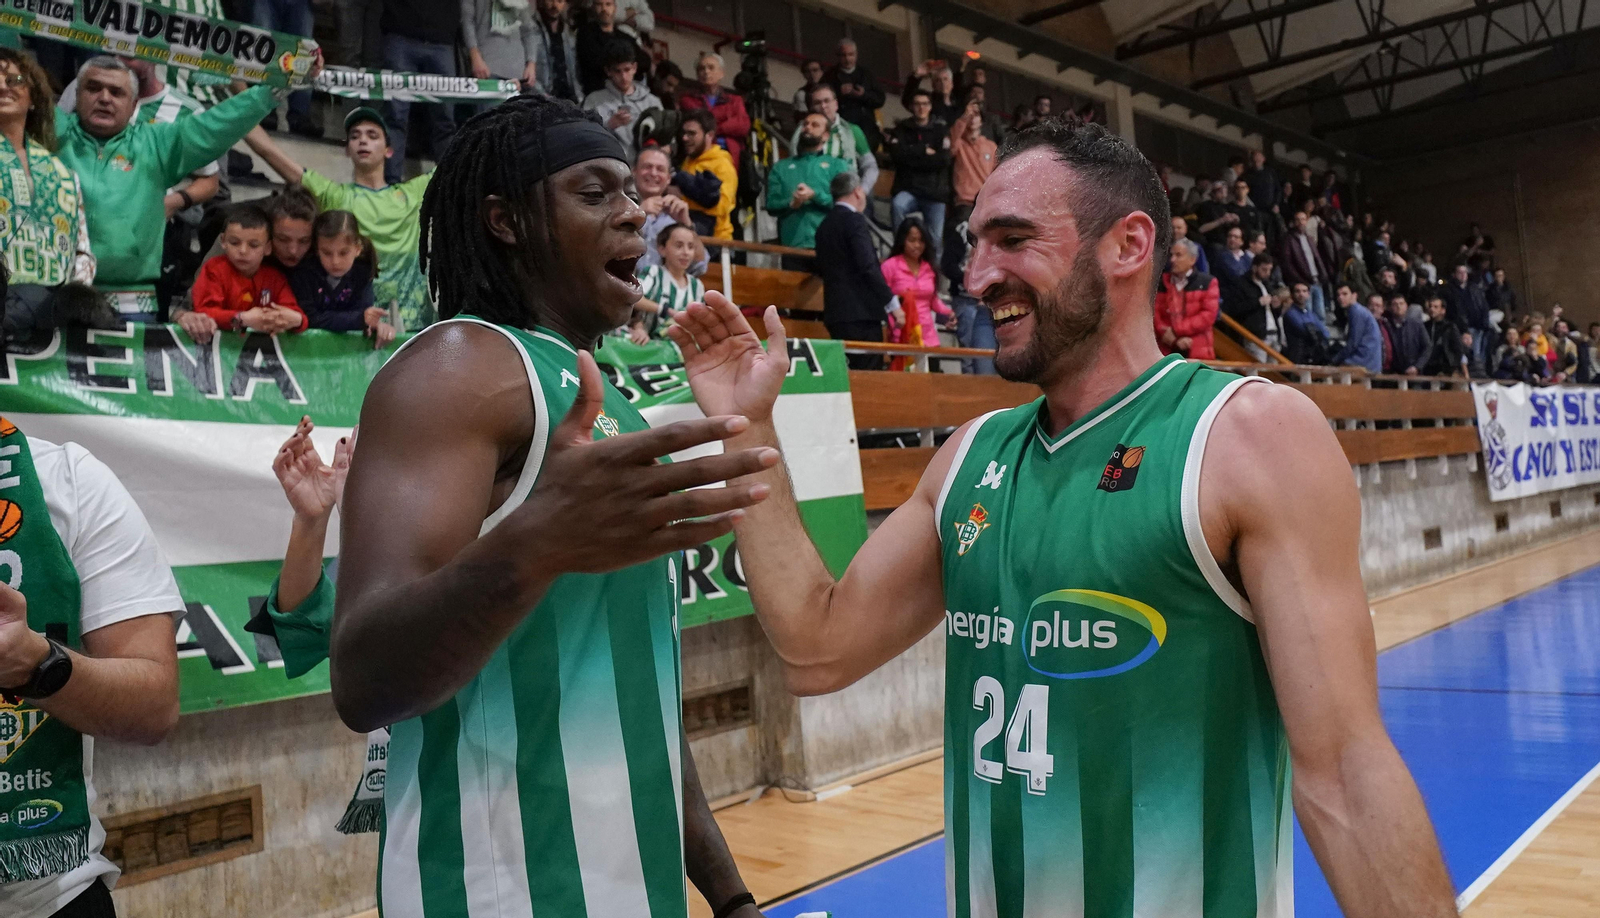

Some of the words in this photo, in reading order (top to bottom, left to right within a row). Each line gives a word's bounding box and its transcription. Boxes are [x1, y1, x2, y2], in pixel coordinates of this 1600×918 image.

[81, 0, 277, 65] VALDEMORO
[1100, 476, 1118, 490] RO
[1103, 464, 1123, 480] EB
[945, 606, 1015, 650] nergía
[1030, 611, 1118, 657] plus
[973, 676, 1054, 796] 24
[0, 768, 53, 794] Betis
[18, 805, 48, 825] plus
